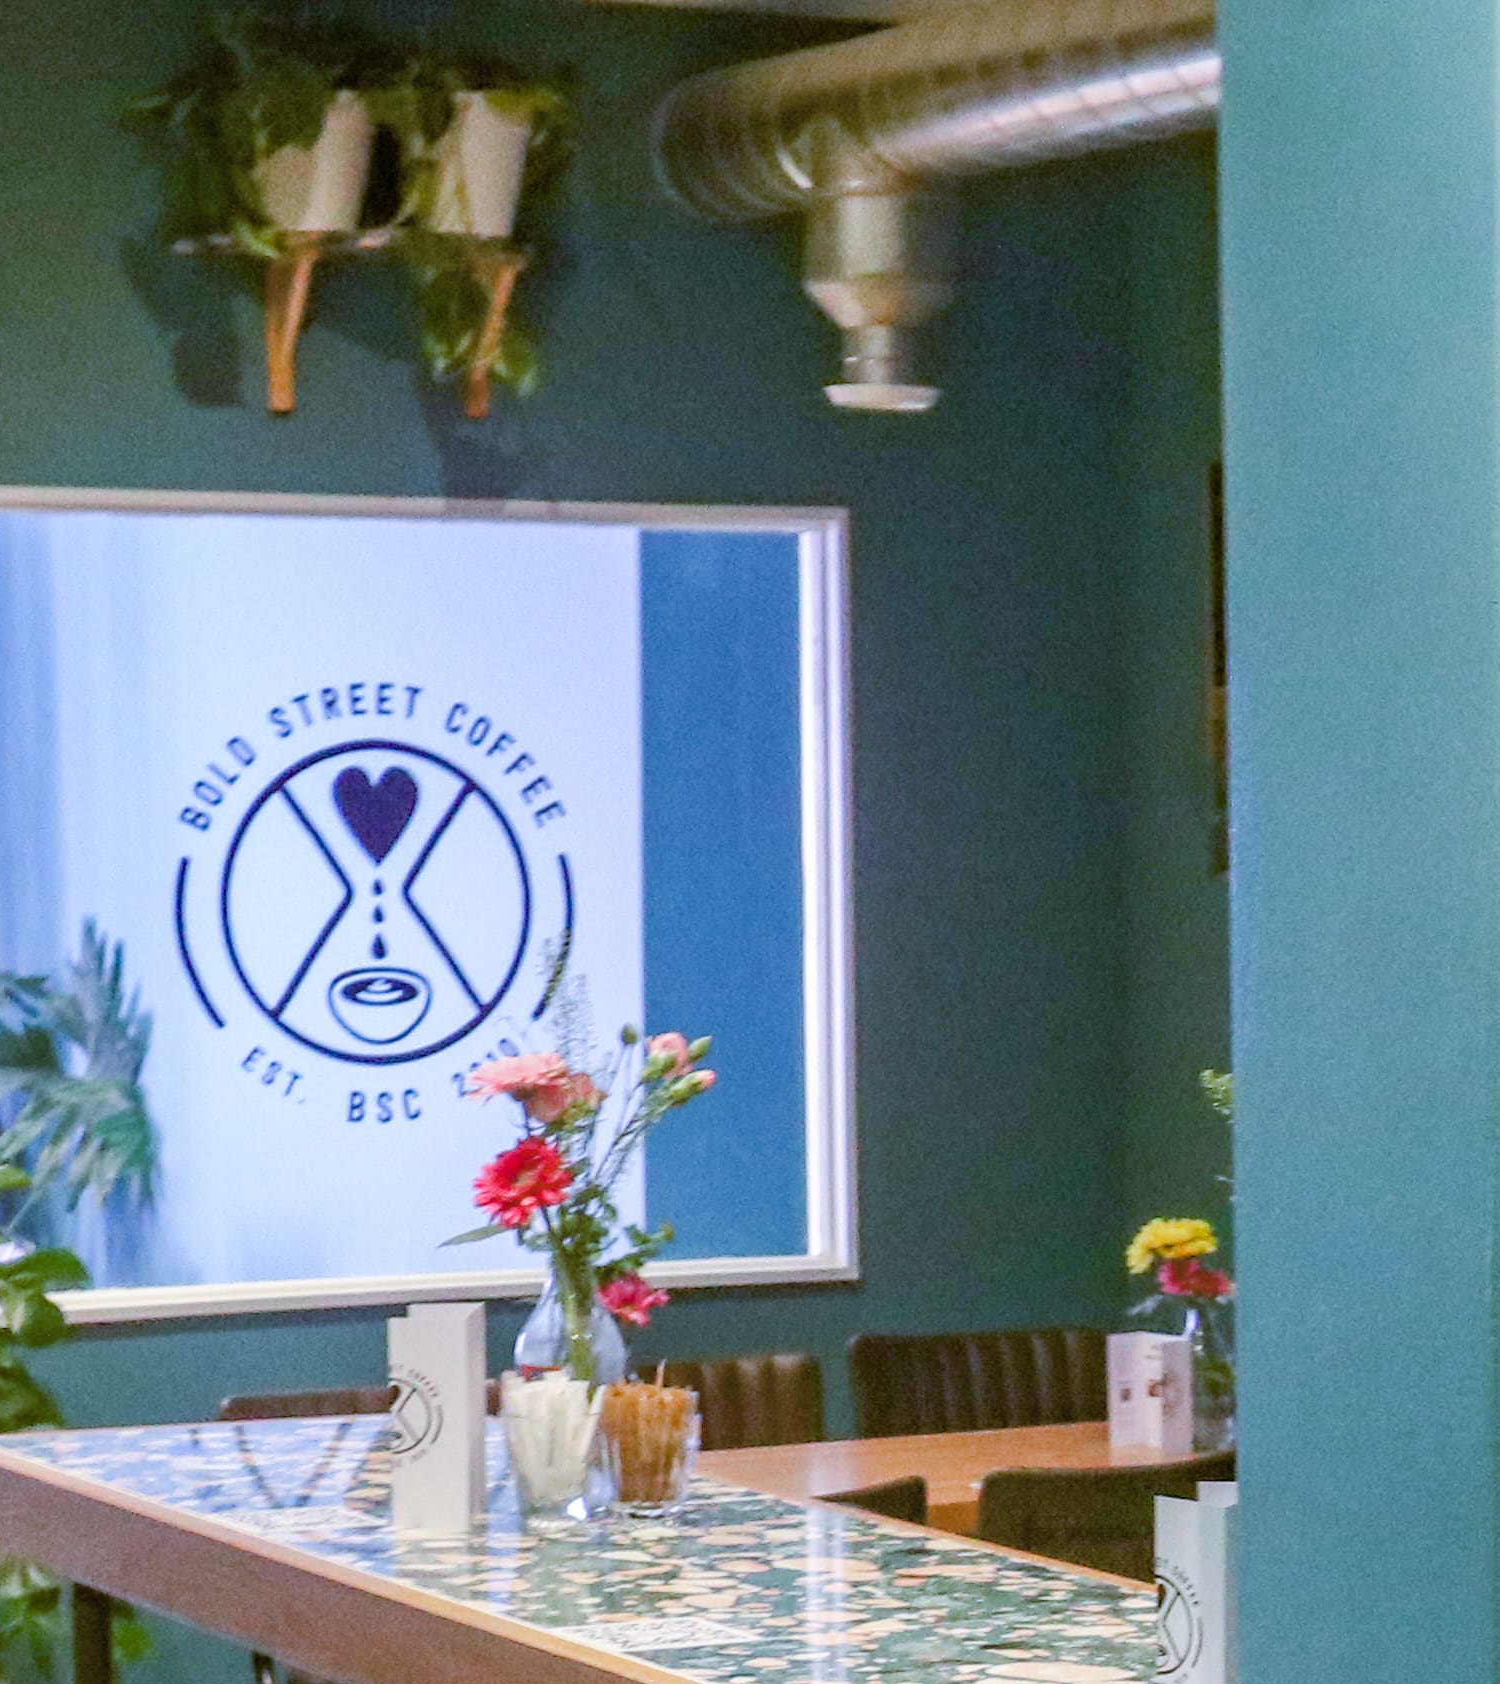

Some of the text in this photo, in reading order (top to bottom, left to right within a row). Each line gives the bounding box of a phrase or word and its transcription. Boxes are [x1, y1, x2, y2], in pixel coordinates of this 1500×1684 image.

[178, 681, 568, 834] BOLD STREET COFFEE
[240, 1044, 307, 1106] EST.
[346, 1087, 424, 1123] BSC
